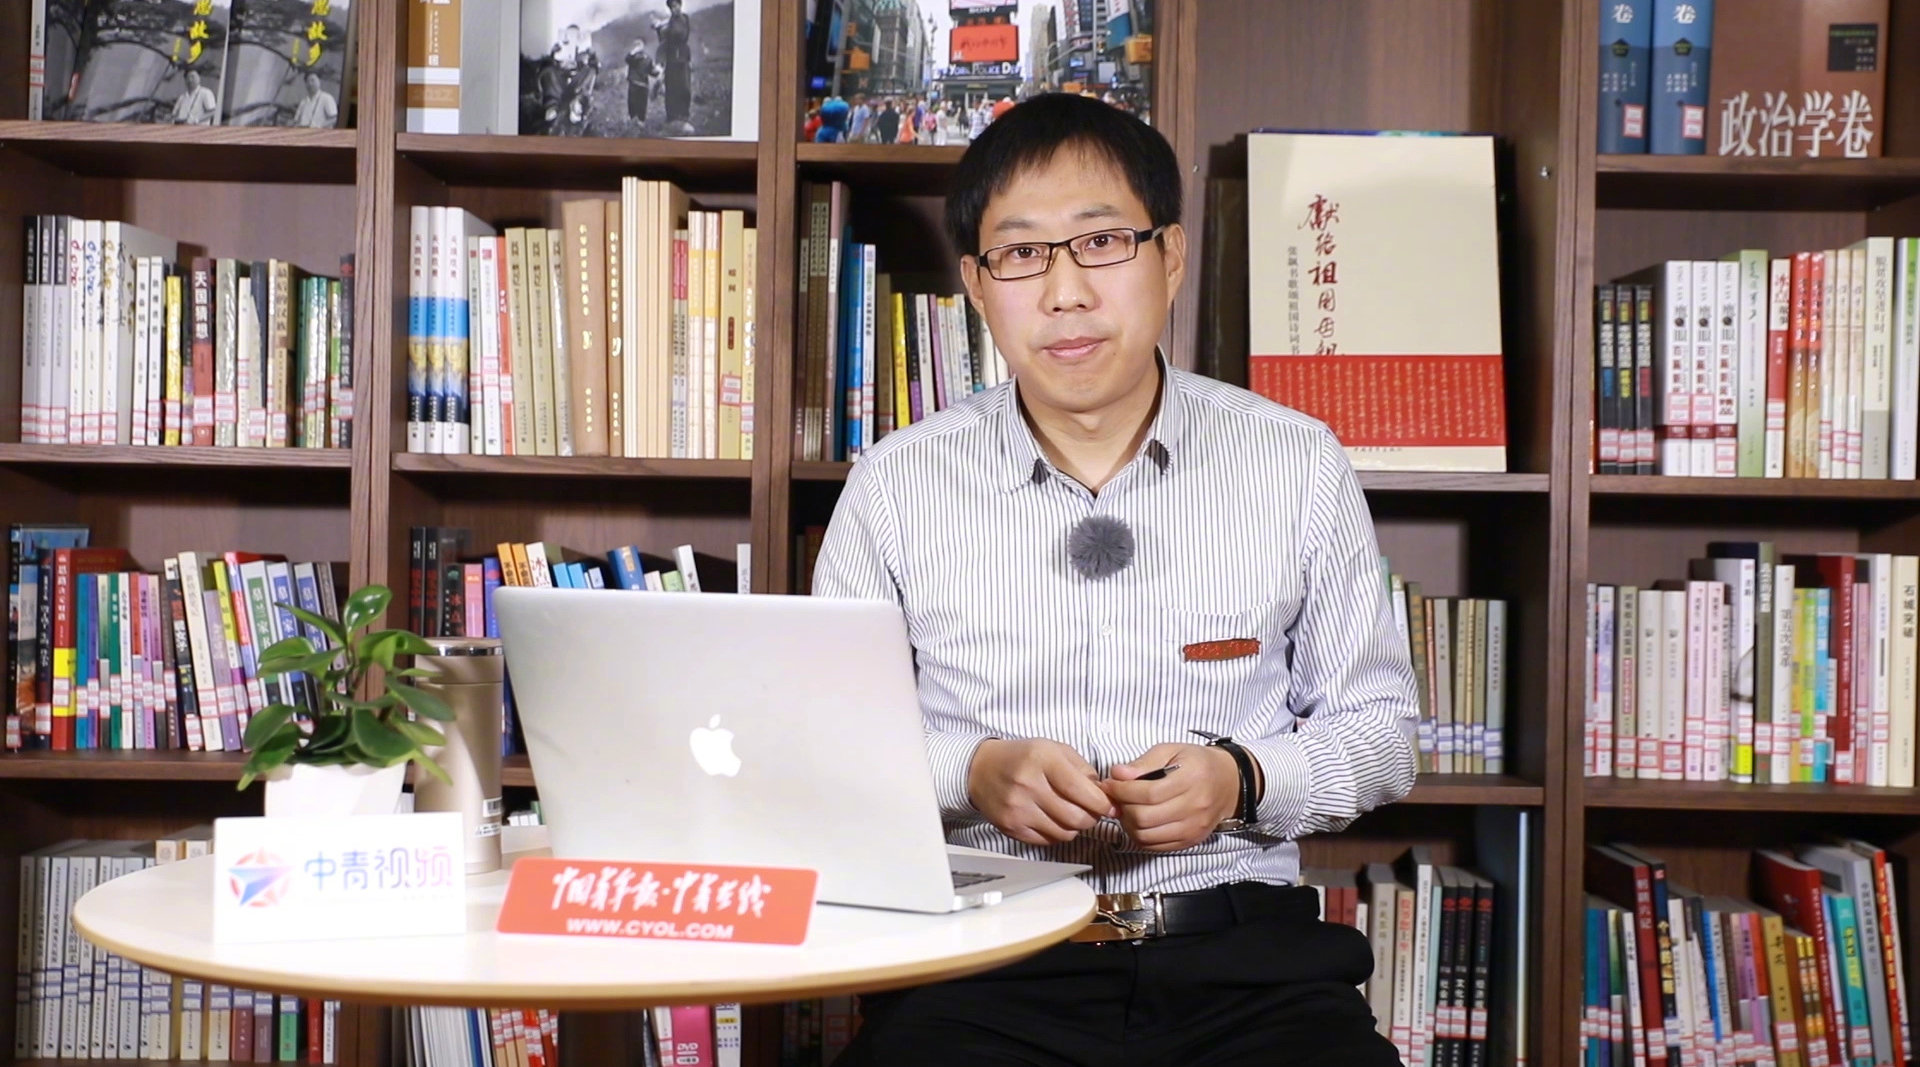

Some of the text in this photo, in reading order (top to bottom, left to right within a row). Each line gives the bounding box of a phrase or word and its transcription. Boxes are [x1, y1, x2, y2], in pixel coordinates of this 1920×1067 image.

[1611, 4, 1633, 24] 卷
[1673, 4, 1696, 24] 卷
[1718, 89, 1875, 158] 政治学卷
[304, 846, 453, 892] 中青视频
[566, 918, 734, 939] WWW.CYOL.COM
